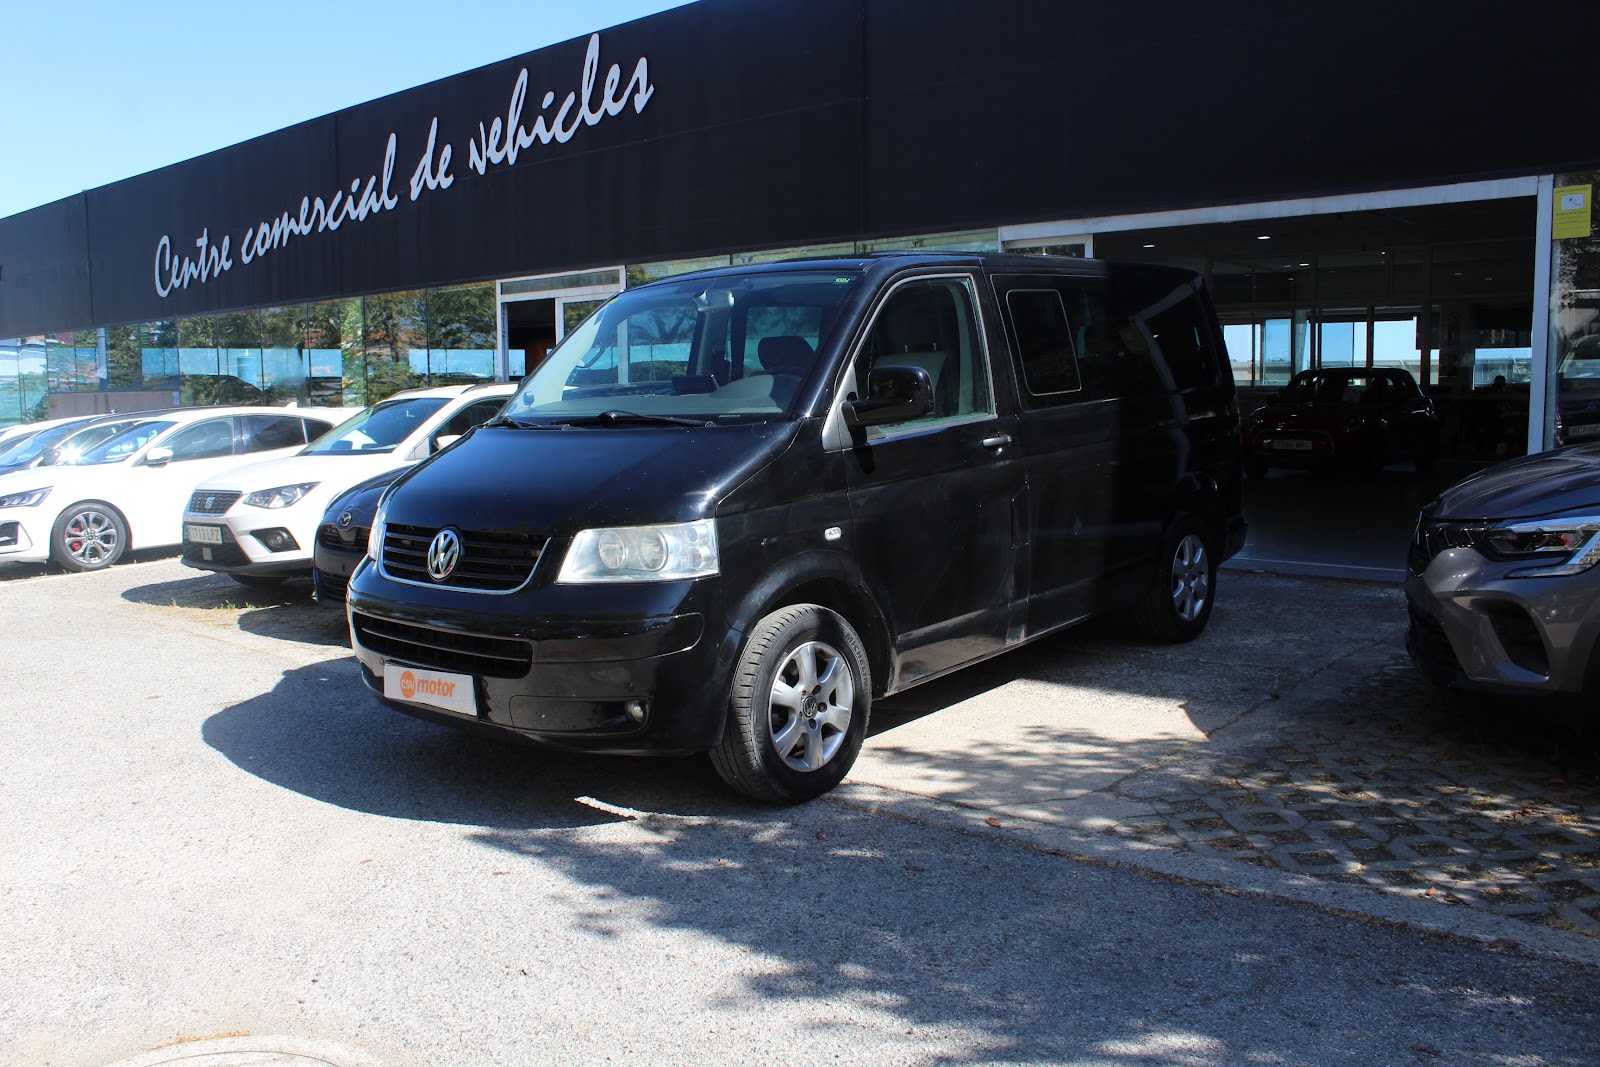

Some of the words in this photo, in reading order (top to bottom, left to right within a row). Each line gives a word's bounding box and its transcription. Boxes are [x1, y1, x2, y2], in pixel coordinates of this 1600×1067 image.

[154, 227, 233, 298] Centre
[240, 132, 399, 265] comercial
[409, 116, 454, 201] de
[468, 33, 655, 176] vehicles
[401, 679, 415, 690] CSV
[417, 679, 456, 697] motor
